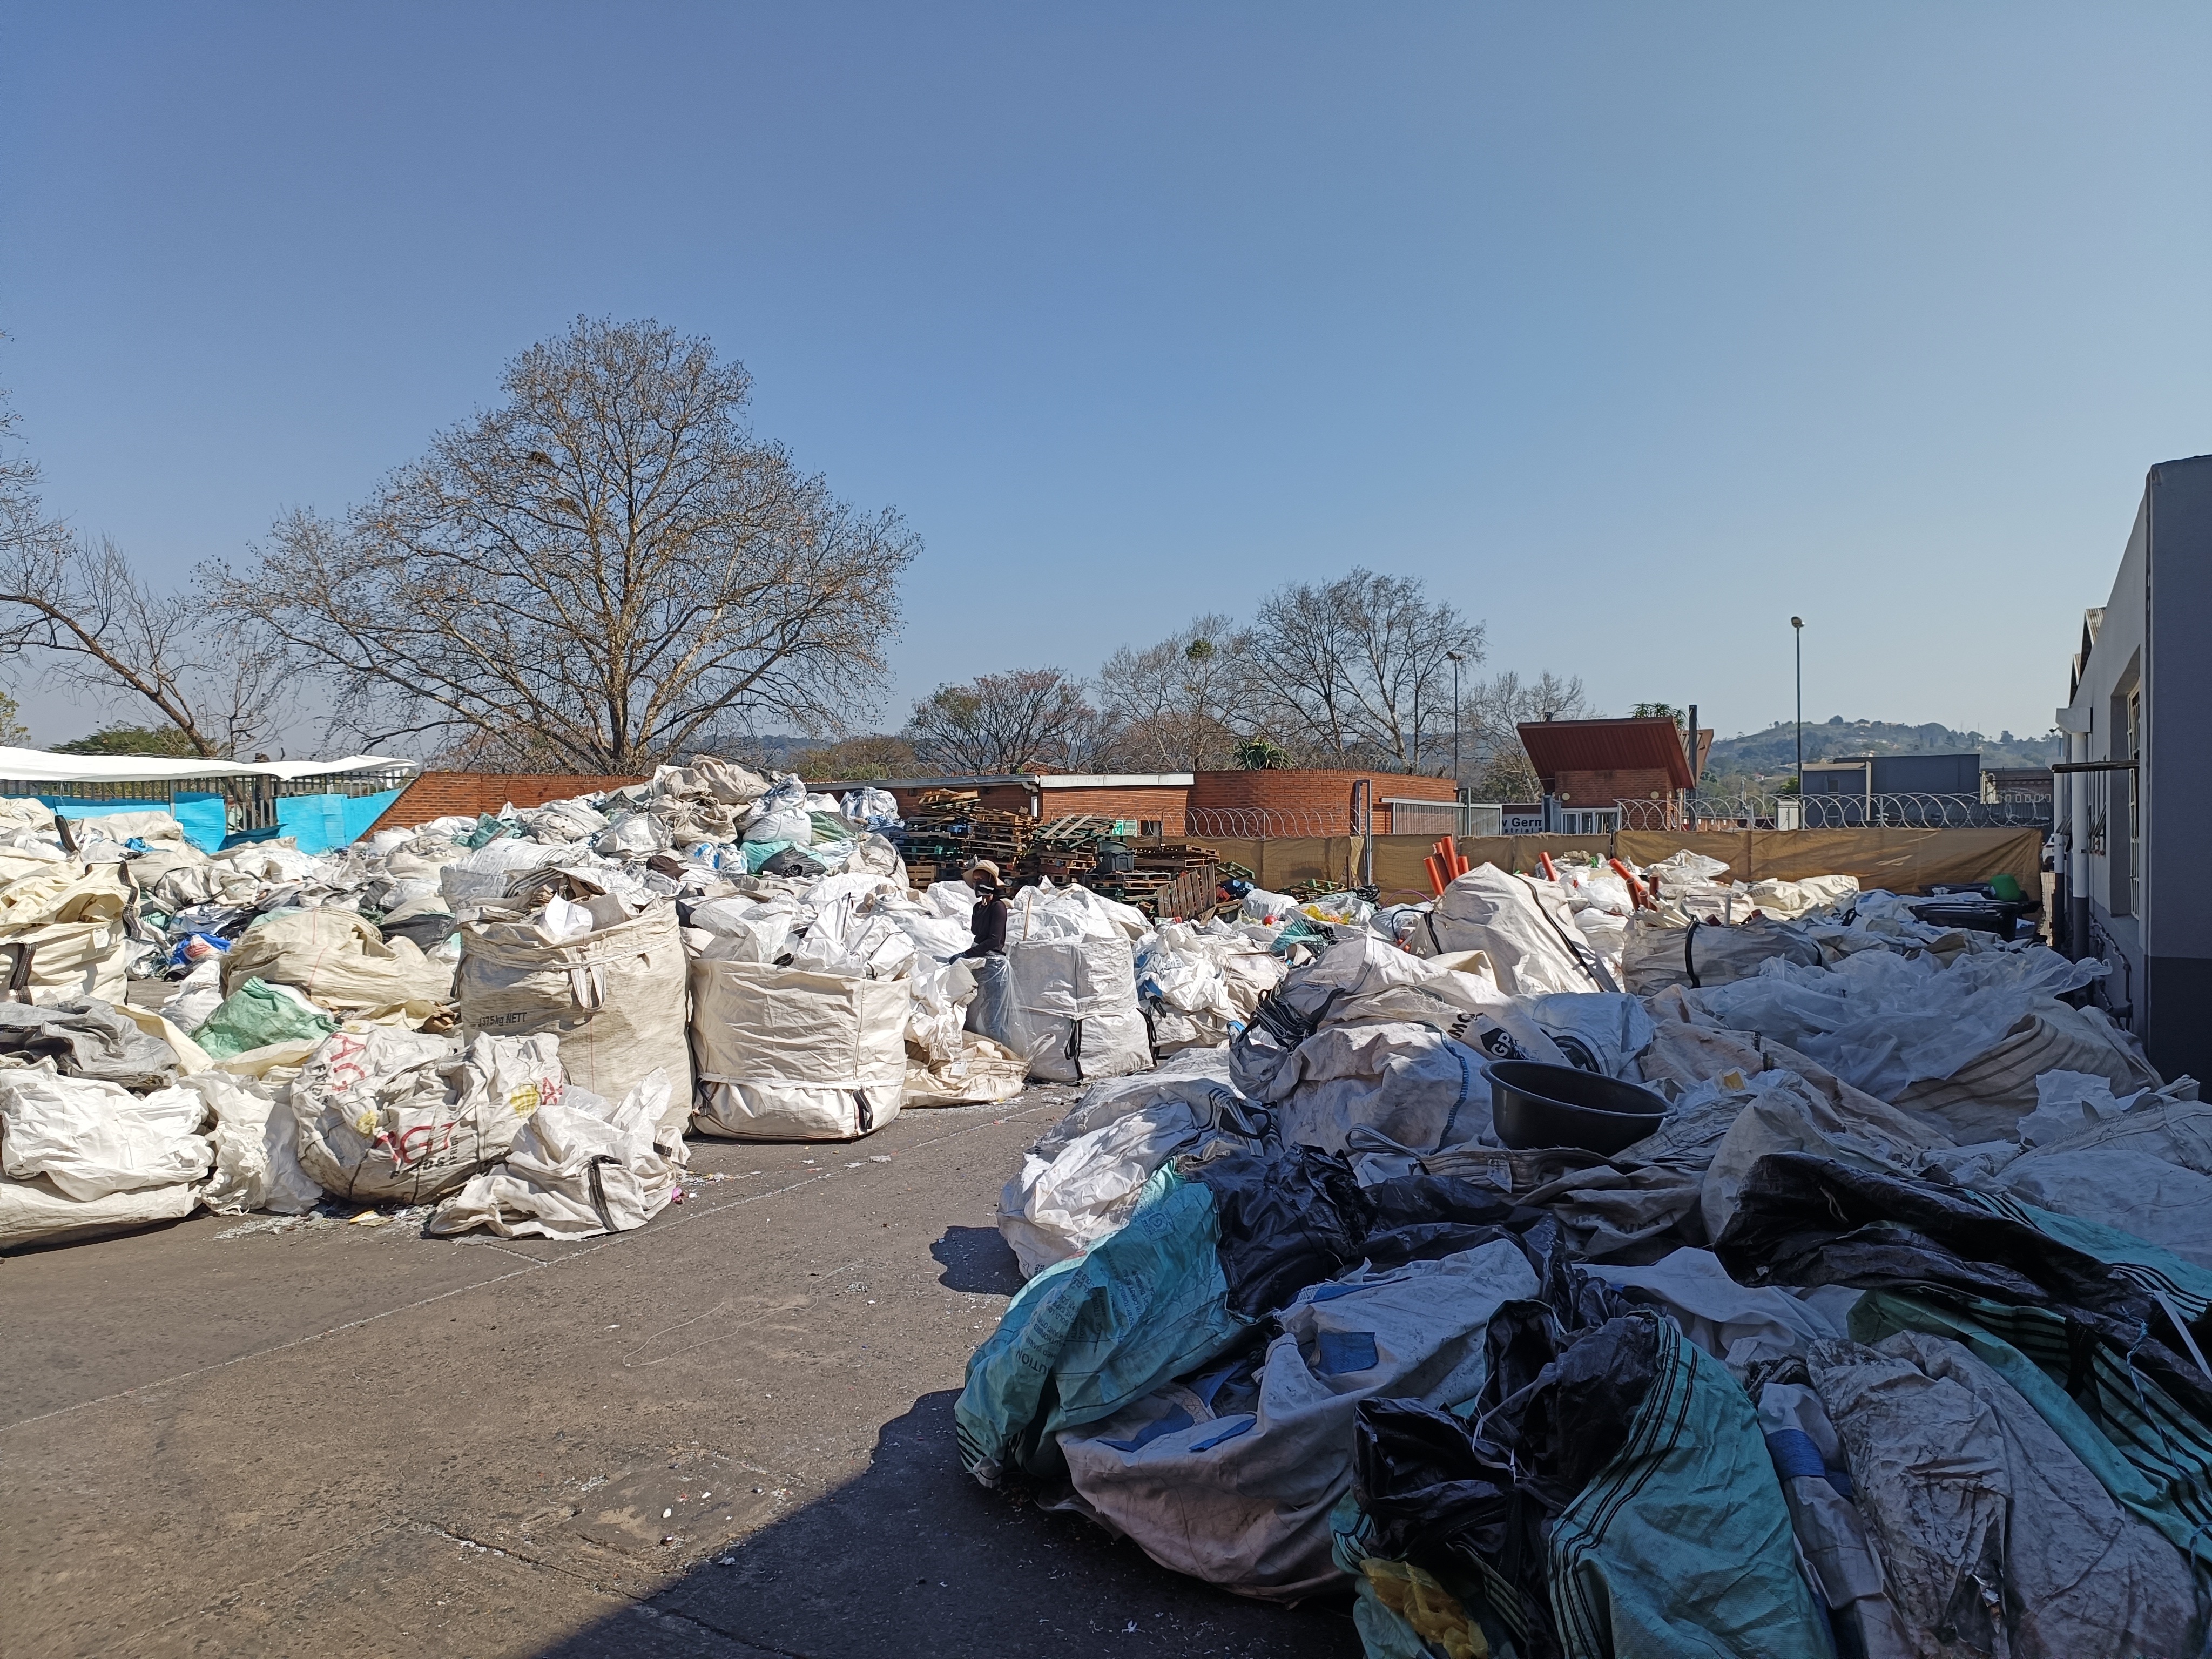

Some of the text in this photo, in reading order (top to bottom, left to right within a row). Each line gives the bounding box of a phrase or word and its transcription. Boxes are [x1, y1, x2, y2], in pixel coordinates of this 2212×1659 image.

[506, 1012, 527, 1024] NETT
[449, 1134, 458, 1165] AFRICA
[1108, 1258, 1120, 1281] HULETT
[1121, 1269, 1132, 1286] ROAD
[1128, 1286, 1139, 1306] COAST
